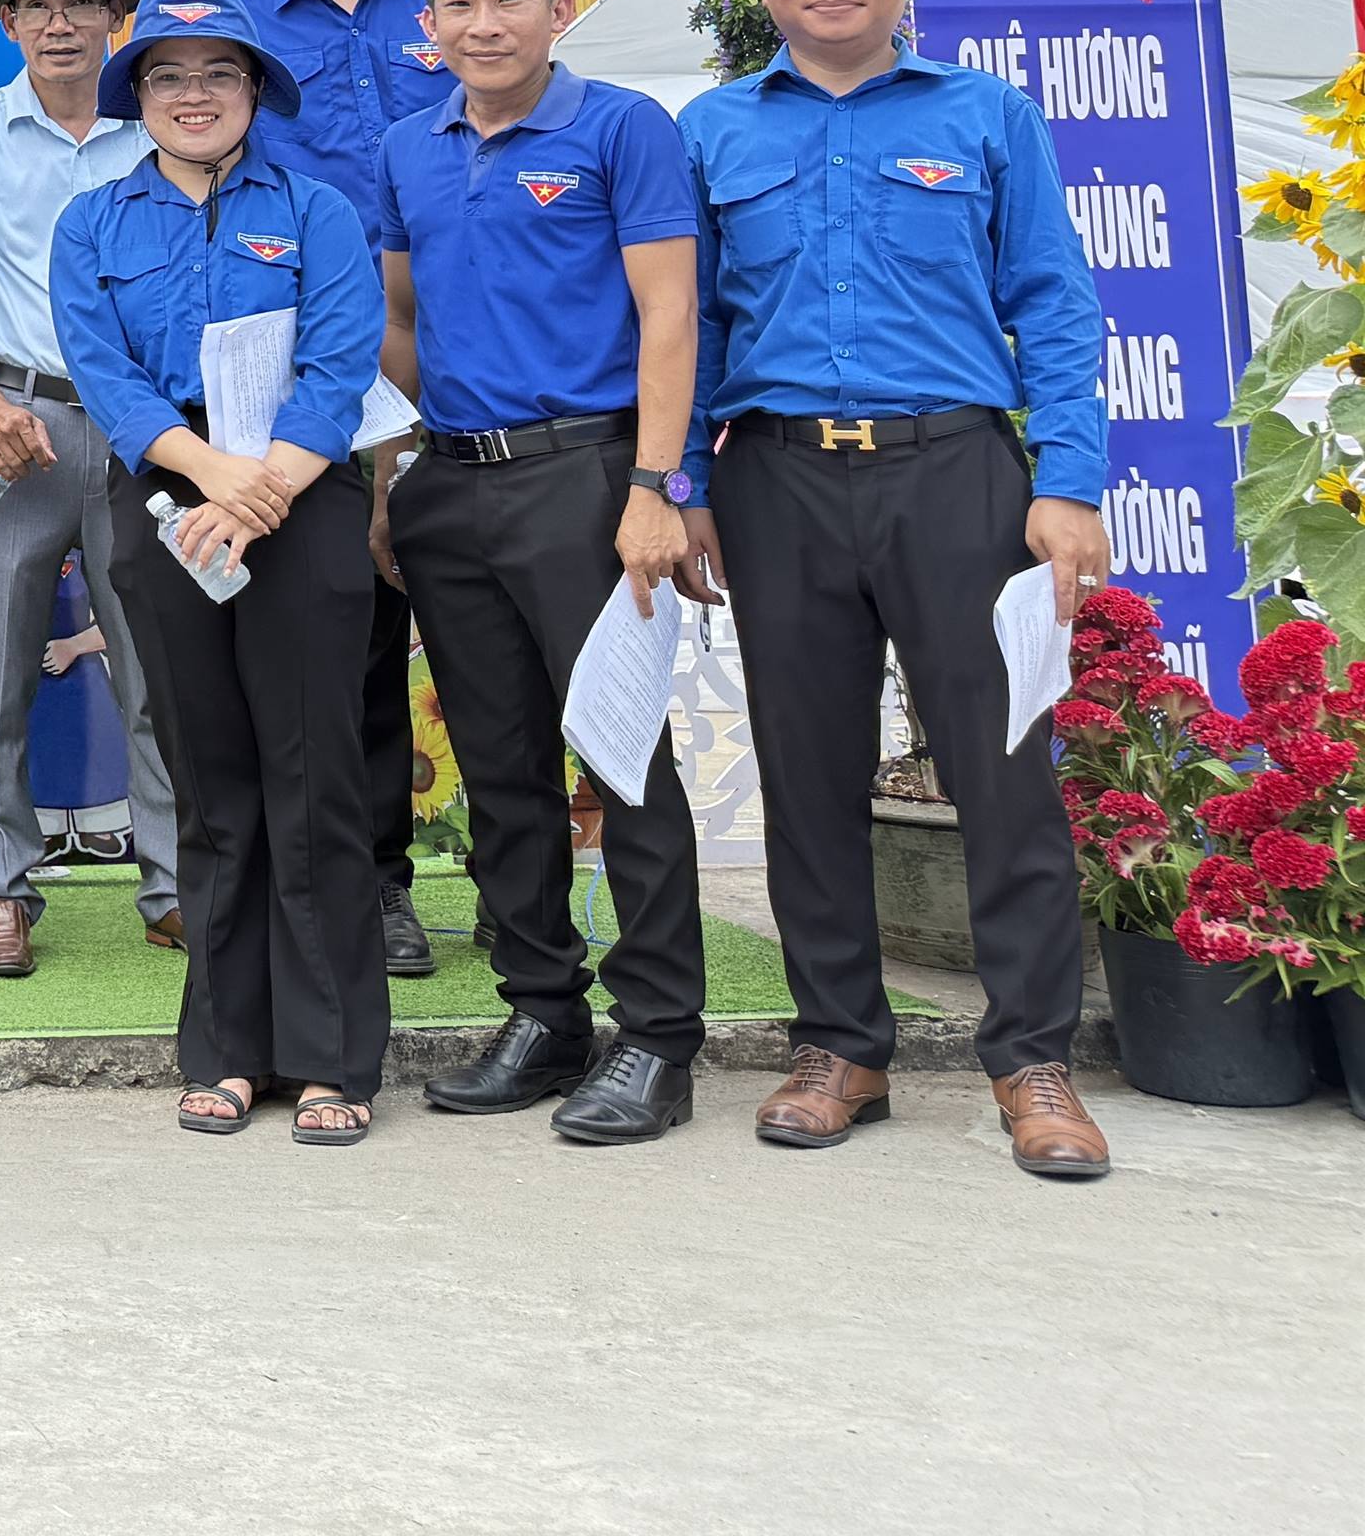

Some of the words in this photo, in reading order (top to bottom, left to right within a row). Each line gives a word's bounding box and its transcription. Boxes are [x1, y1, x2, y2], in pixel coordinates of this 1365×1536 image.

[1038, 27, 1168, 120] HƯƠNG
[1065, 167, 1171, 269] HÙNG
[1095, 317, 1184, 421] ÀNG
[1099, 467, 1207, 576] ƯỜNG
